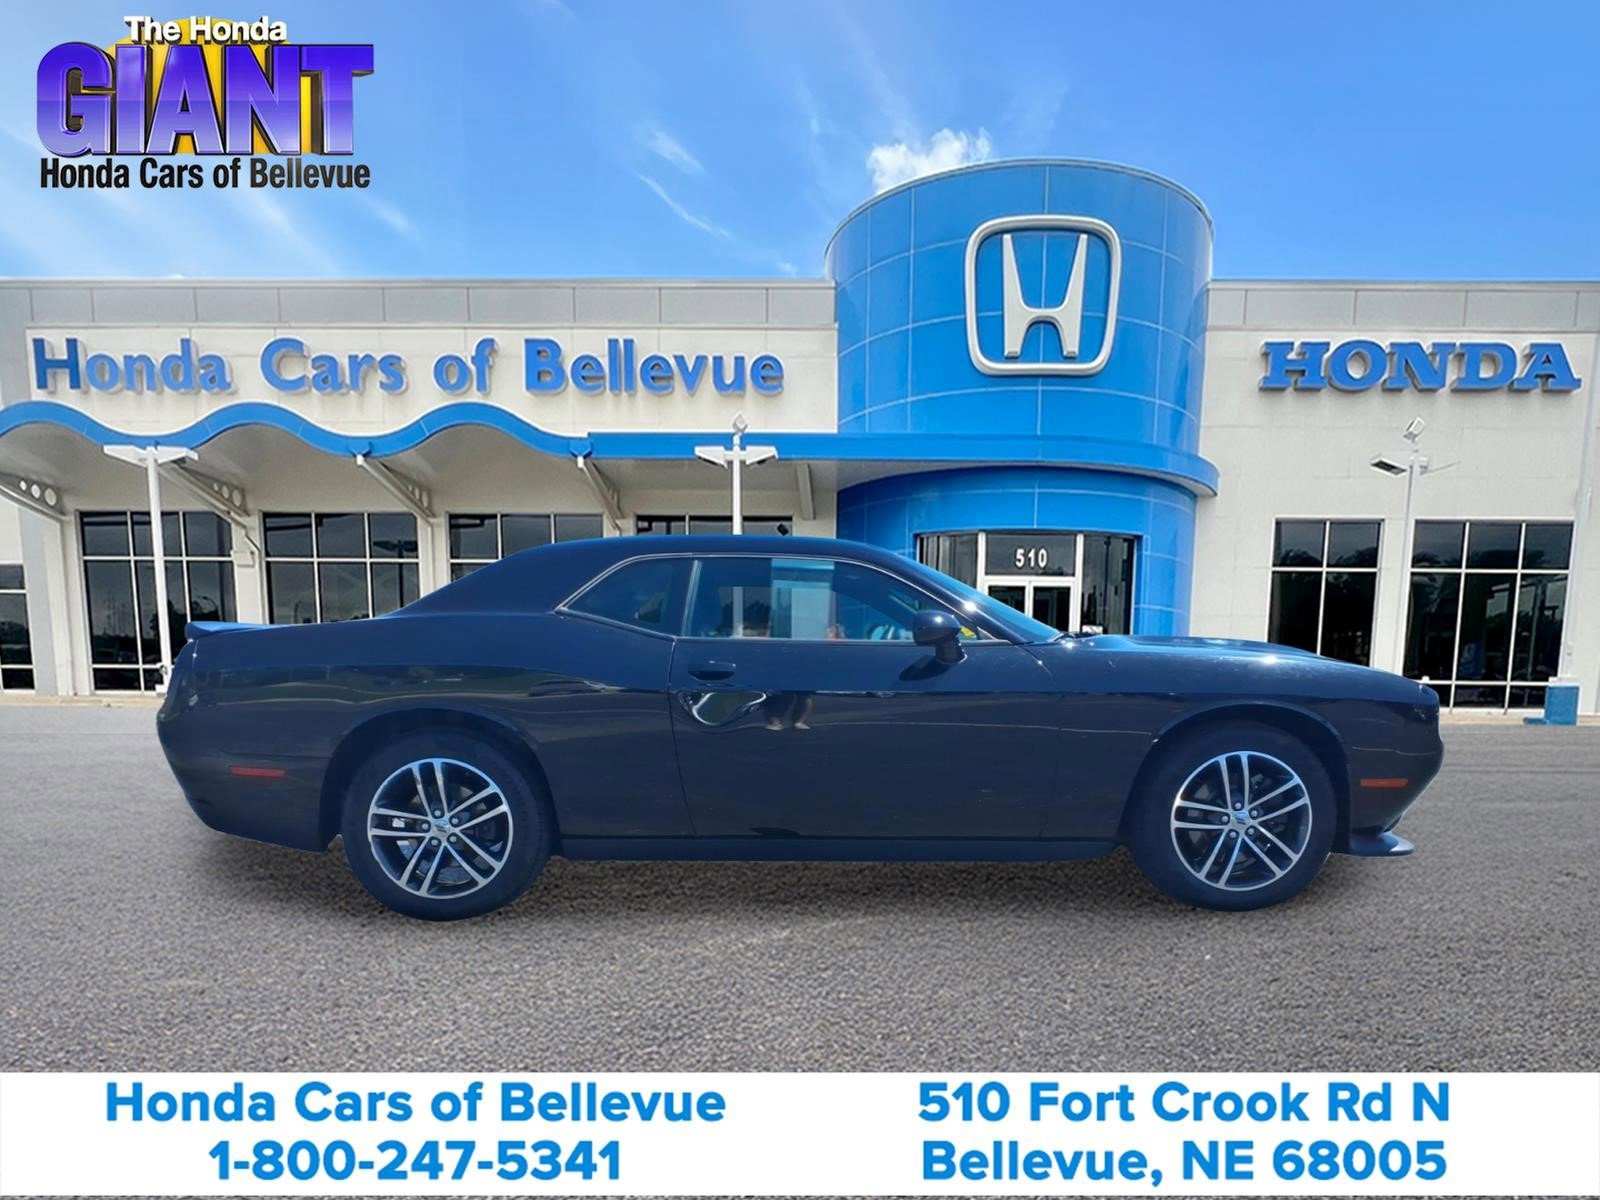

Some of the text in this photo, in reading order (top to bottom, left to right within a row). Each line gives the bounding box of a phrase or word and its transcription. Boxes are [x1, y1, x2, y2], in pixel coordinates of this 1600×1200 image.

[32, 337, 785, 396] Honda Cars of Bellevue
[1260, 340, 1582, 392] HONDA
[1014, 548, 1049, 569] 510
